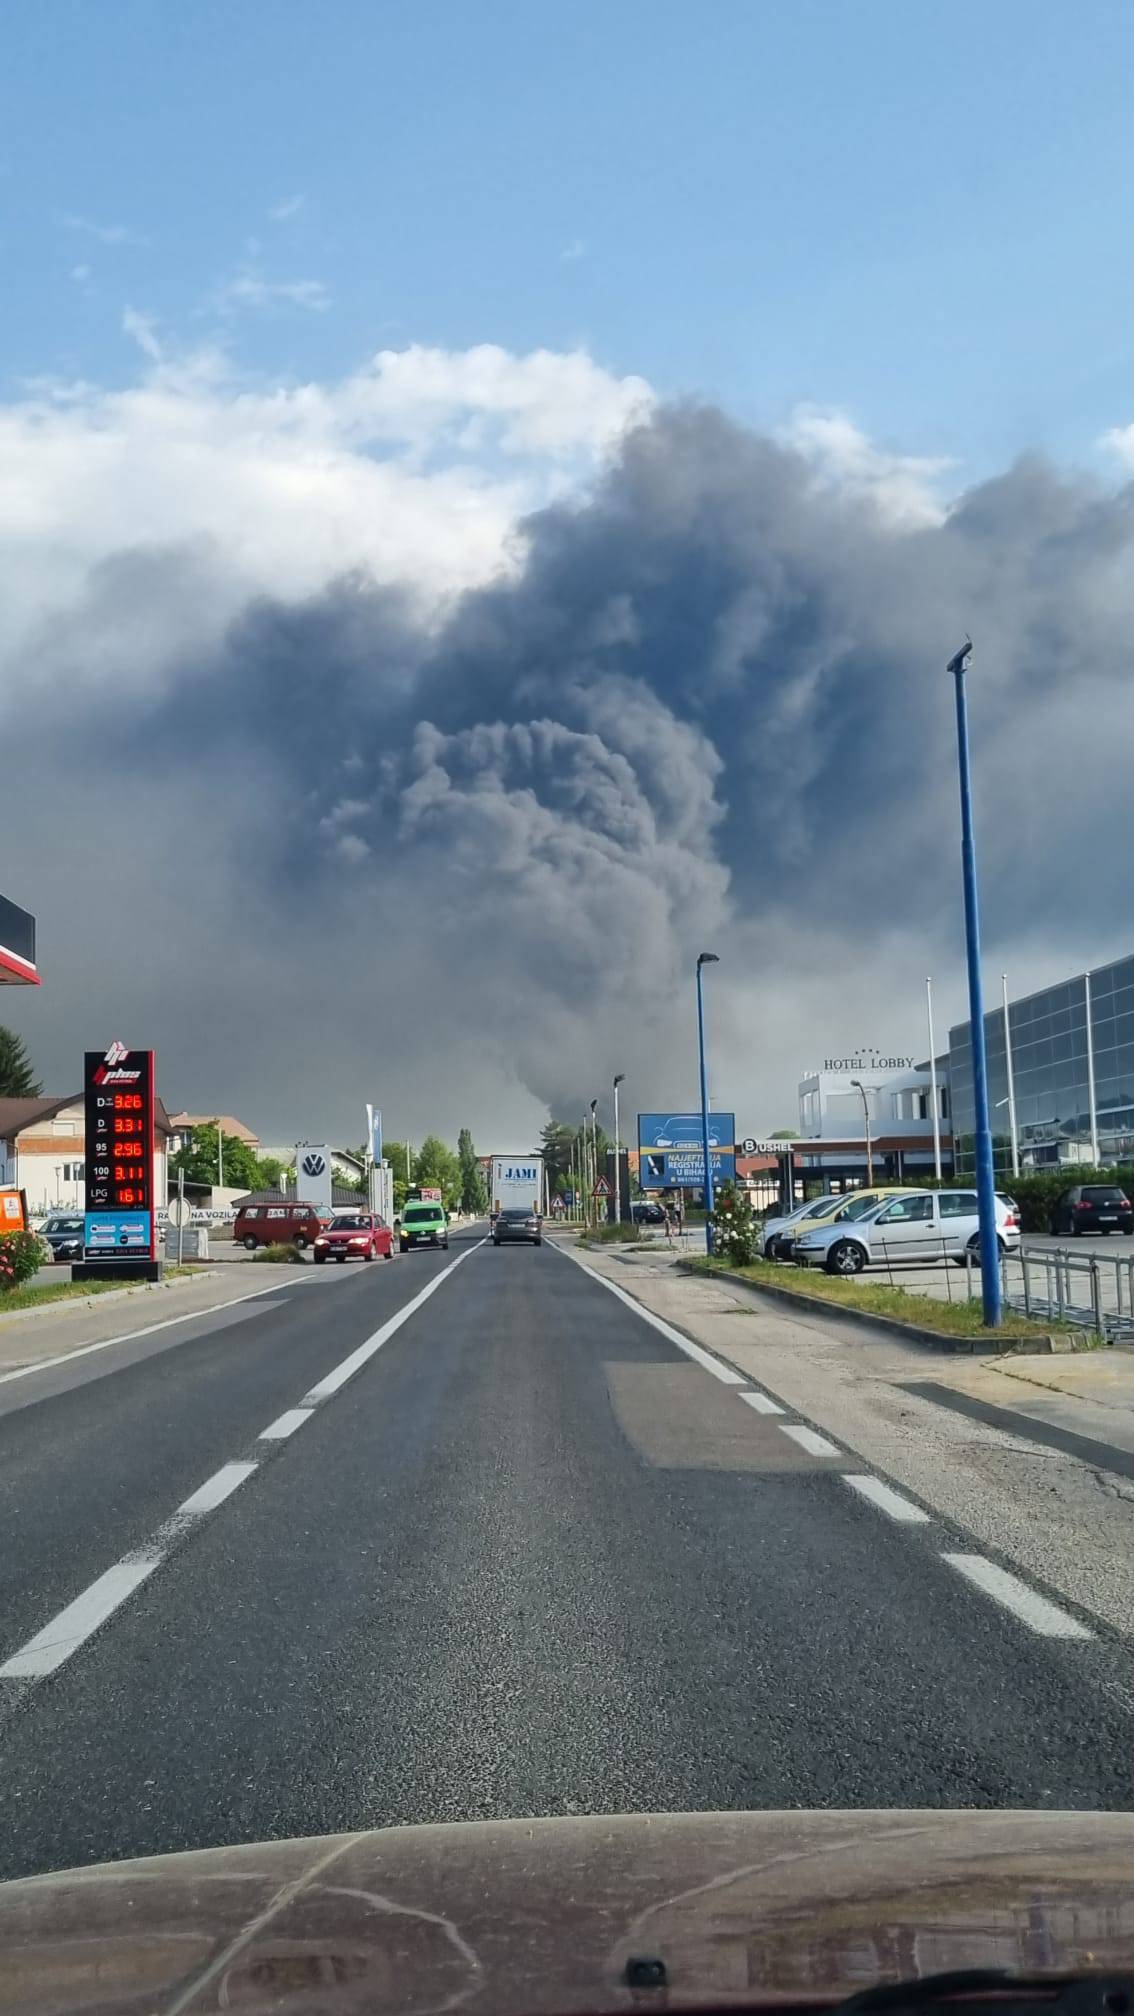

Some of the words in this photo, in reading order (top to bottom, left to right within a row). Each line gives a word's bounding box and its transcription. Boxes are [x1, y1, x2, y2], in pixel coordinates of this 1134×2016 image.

[824, 1058, 866, 1070] HOTEL
[871, 1057, 914, 1069] LOBBY
[114, 1094, 142, 1109] 3.26
[97, 1119, 105, 1127] D
[114, 1119, 143, 1132] 3.31
[95, 1143, 107, 1151] 95
[114, 1143, 142, 1156] 2.96
[93, 1167, 109, 1175] 100
[114, 1167, 143, 1180] 3.11
[90, 1188, 108, 1198] LPG
